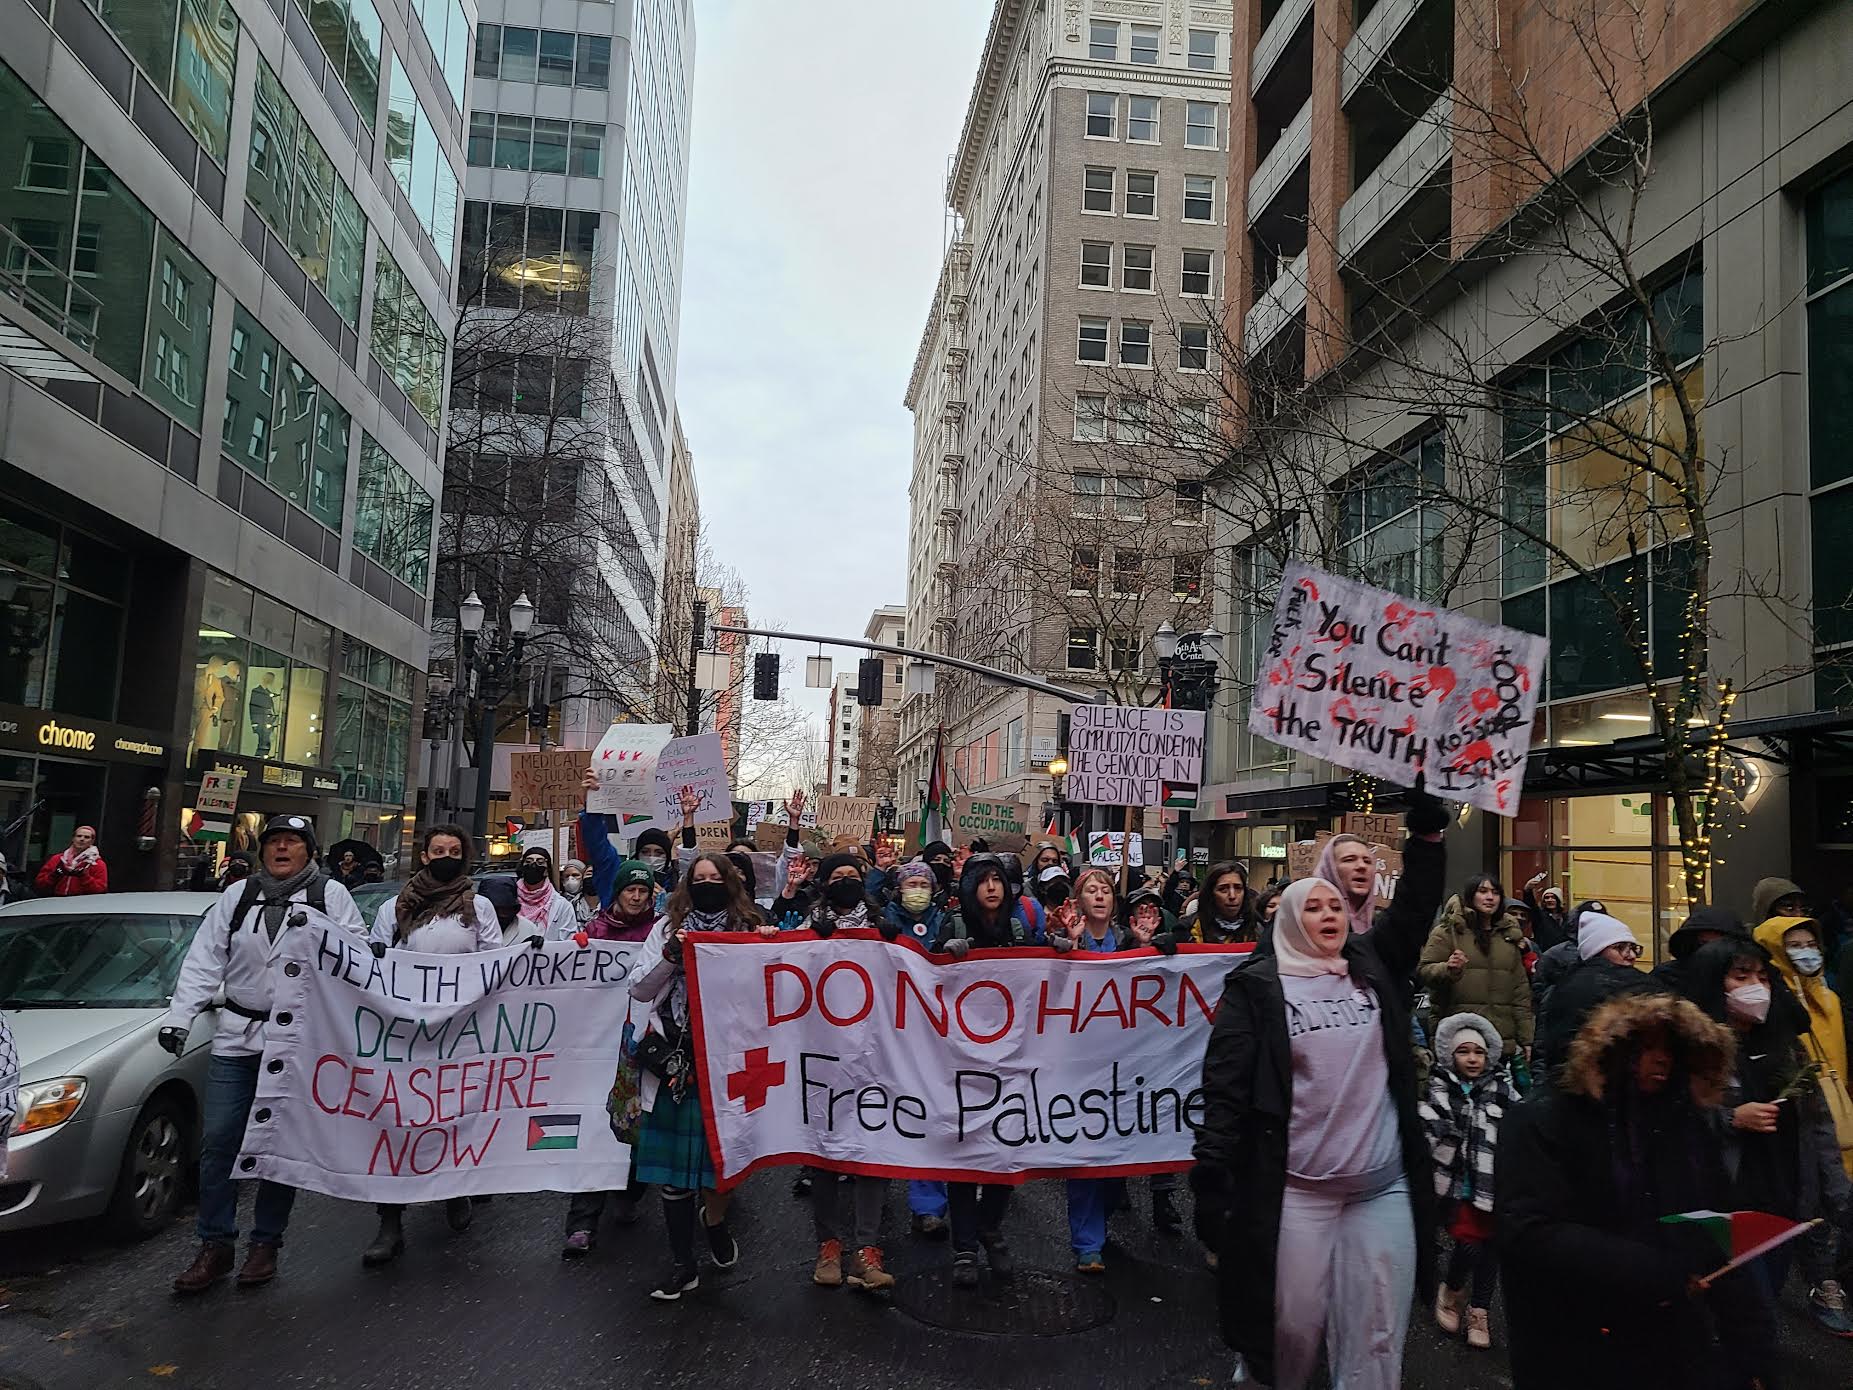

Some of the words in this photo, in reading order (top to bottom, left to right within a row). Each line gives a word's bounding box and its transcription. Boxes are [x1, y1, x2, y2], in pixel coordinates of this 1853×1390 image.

[1318, 601, 1365, 644] You
[1175, 641, 1189, 655] 6th
[1302, 653, 1425, 708] Silence
[1073, 706, 1150, 731] SILENCE
[1163, 712, 1184, 731] IS
[1275, 699, 1321, 741] the
[1335, 716, 1427, 767] TRUTH
[39, 720, 96, 750] chrome
[1069, 728, 1136, 754] COMPLICITY!
[1139, 732, 1202, 758] CONDEMN
[521, 754, 582, 769] MEDICAL
[533, 768, 586, 783] STUDEN
[1070, 751, 1092, 773] THE
[1096, 752, 1166, 780] GENOCIDE
[1172, 758, 1191, 780] IN
[206, 777, 235, 789] FREE
[1067, 775, 1159, 806] PALESTINE!
[199, 797, 235, 810] PALESTINE
[821, 801, 838, 820] NO
[842, 802, 875, 821] MORE
[971, 802, 991, 816] END
[995, 805, 1014, 818] THE
[960, 815, 1024, 834] OCCUPATION
[1352, 816, 1396, 833] FREE
[318, 929, 460, 1003] HEALTH
[481, 949, 630, 996] WORKERS
[765, 961, 874, 1028] DO
[896, 971, 1015, 1044] NO
[355, 1003, 556, 1062] DEMAND
[312, 1054, 555, 1128] CEASEFIRE
[800, 1053, 926, 1138] Free
[956, 1062, 1205, 1147] Palestine
[368, 1118, 501, 1176] NOW
